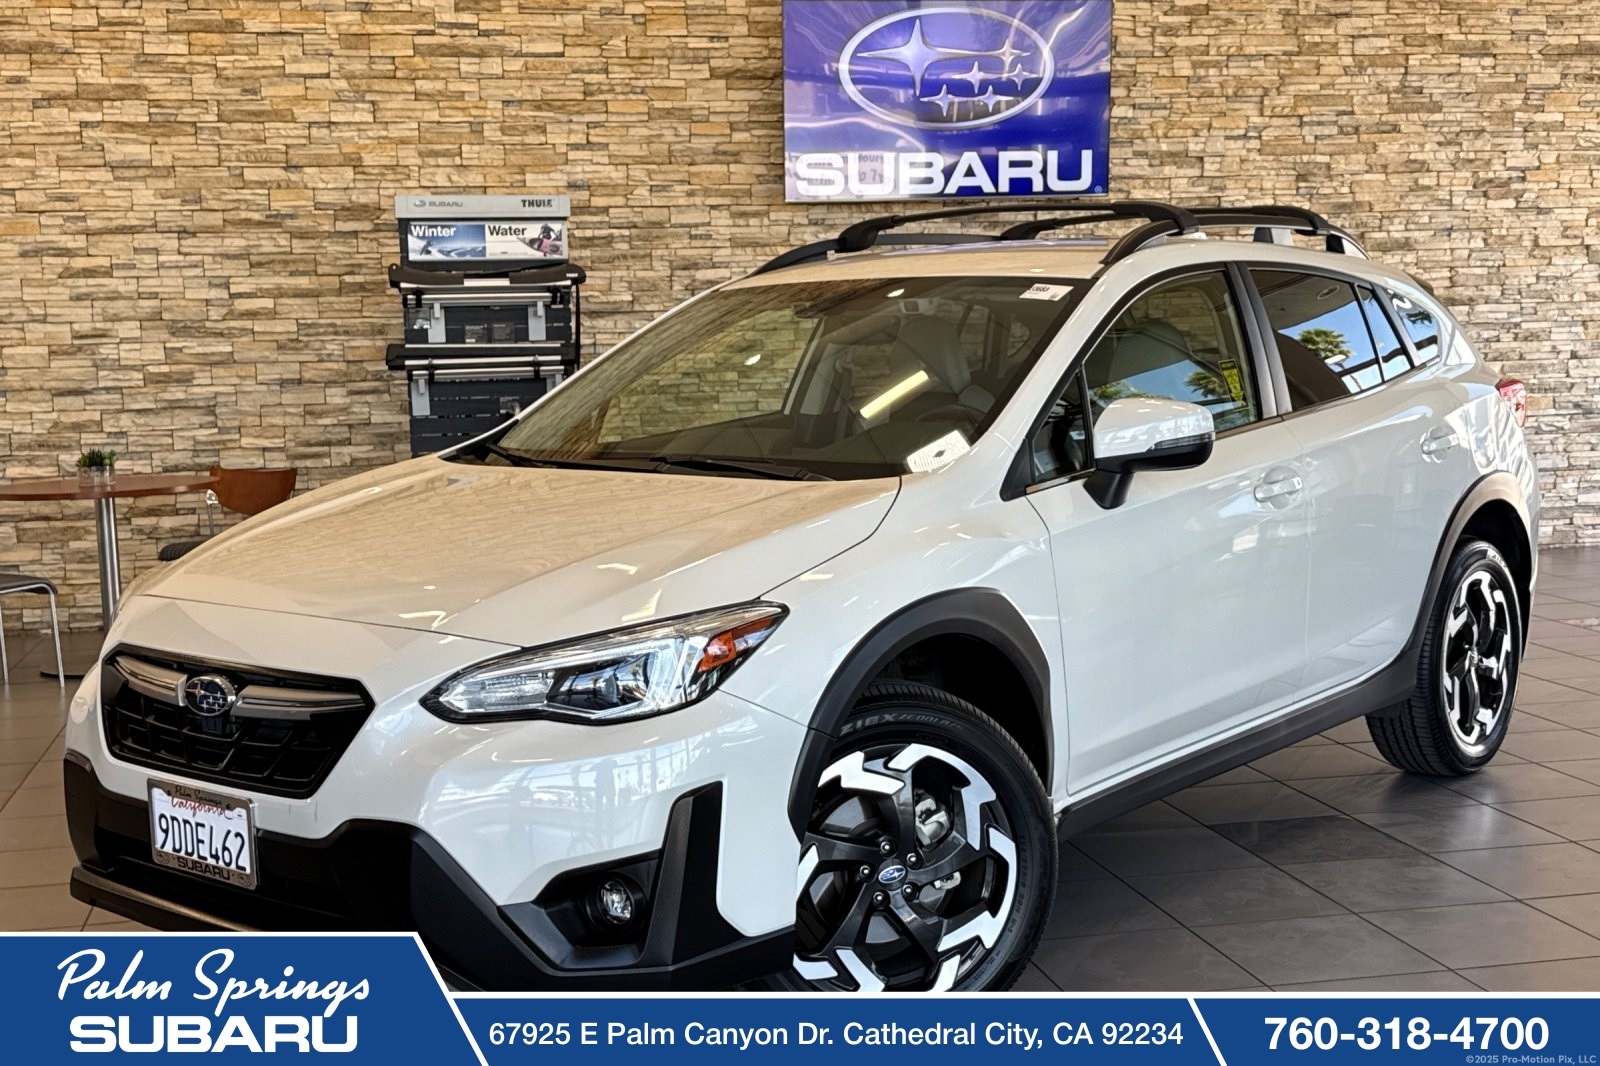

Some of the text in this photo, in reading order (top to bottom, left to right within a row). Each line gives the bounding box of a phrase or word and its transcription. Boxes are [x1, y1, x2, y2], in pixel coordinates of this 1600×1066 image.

[795, 150, 1093, 196] SUBARU
[521, 199, 552, 207] THULE
[411, 226, 456, 237] Winter
[488, 226, 527, 236] Water
[840, 713, 898, 737] ZIEX
[158, 813, 247, 872] 9DDE462
[177, 857, 231, 880] SUBARU
